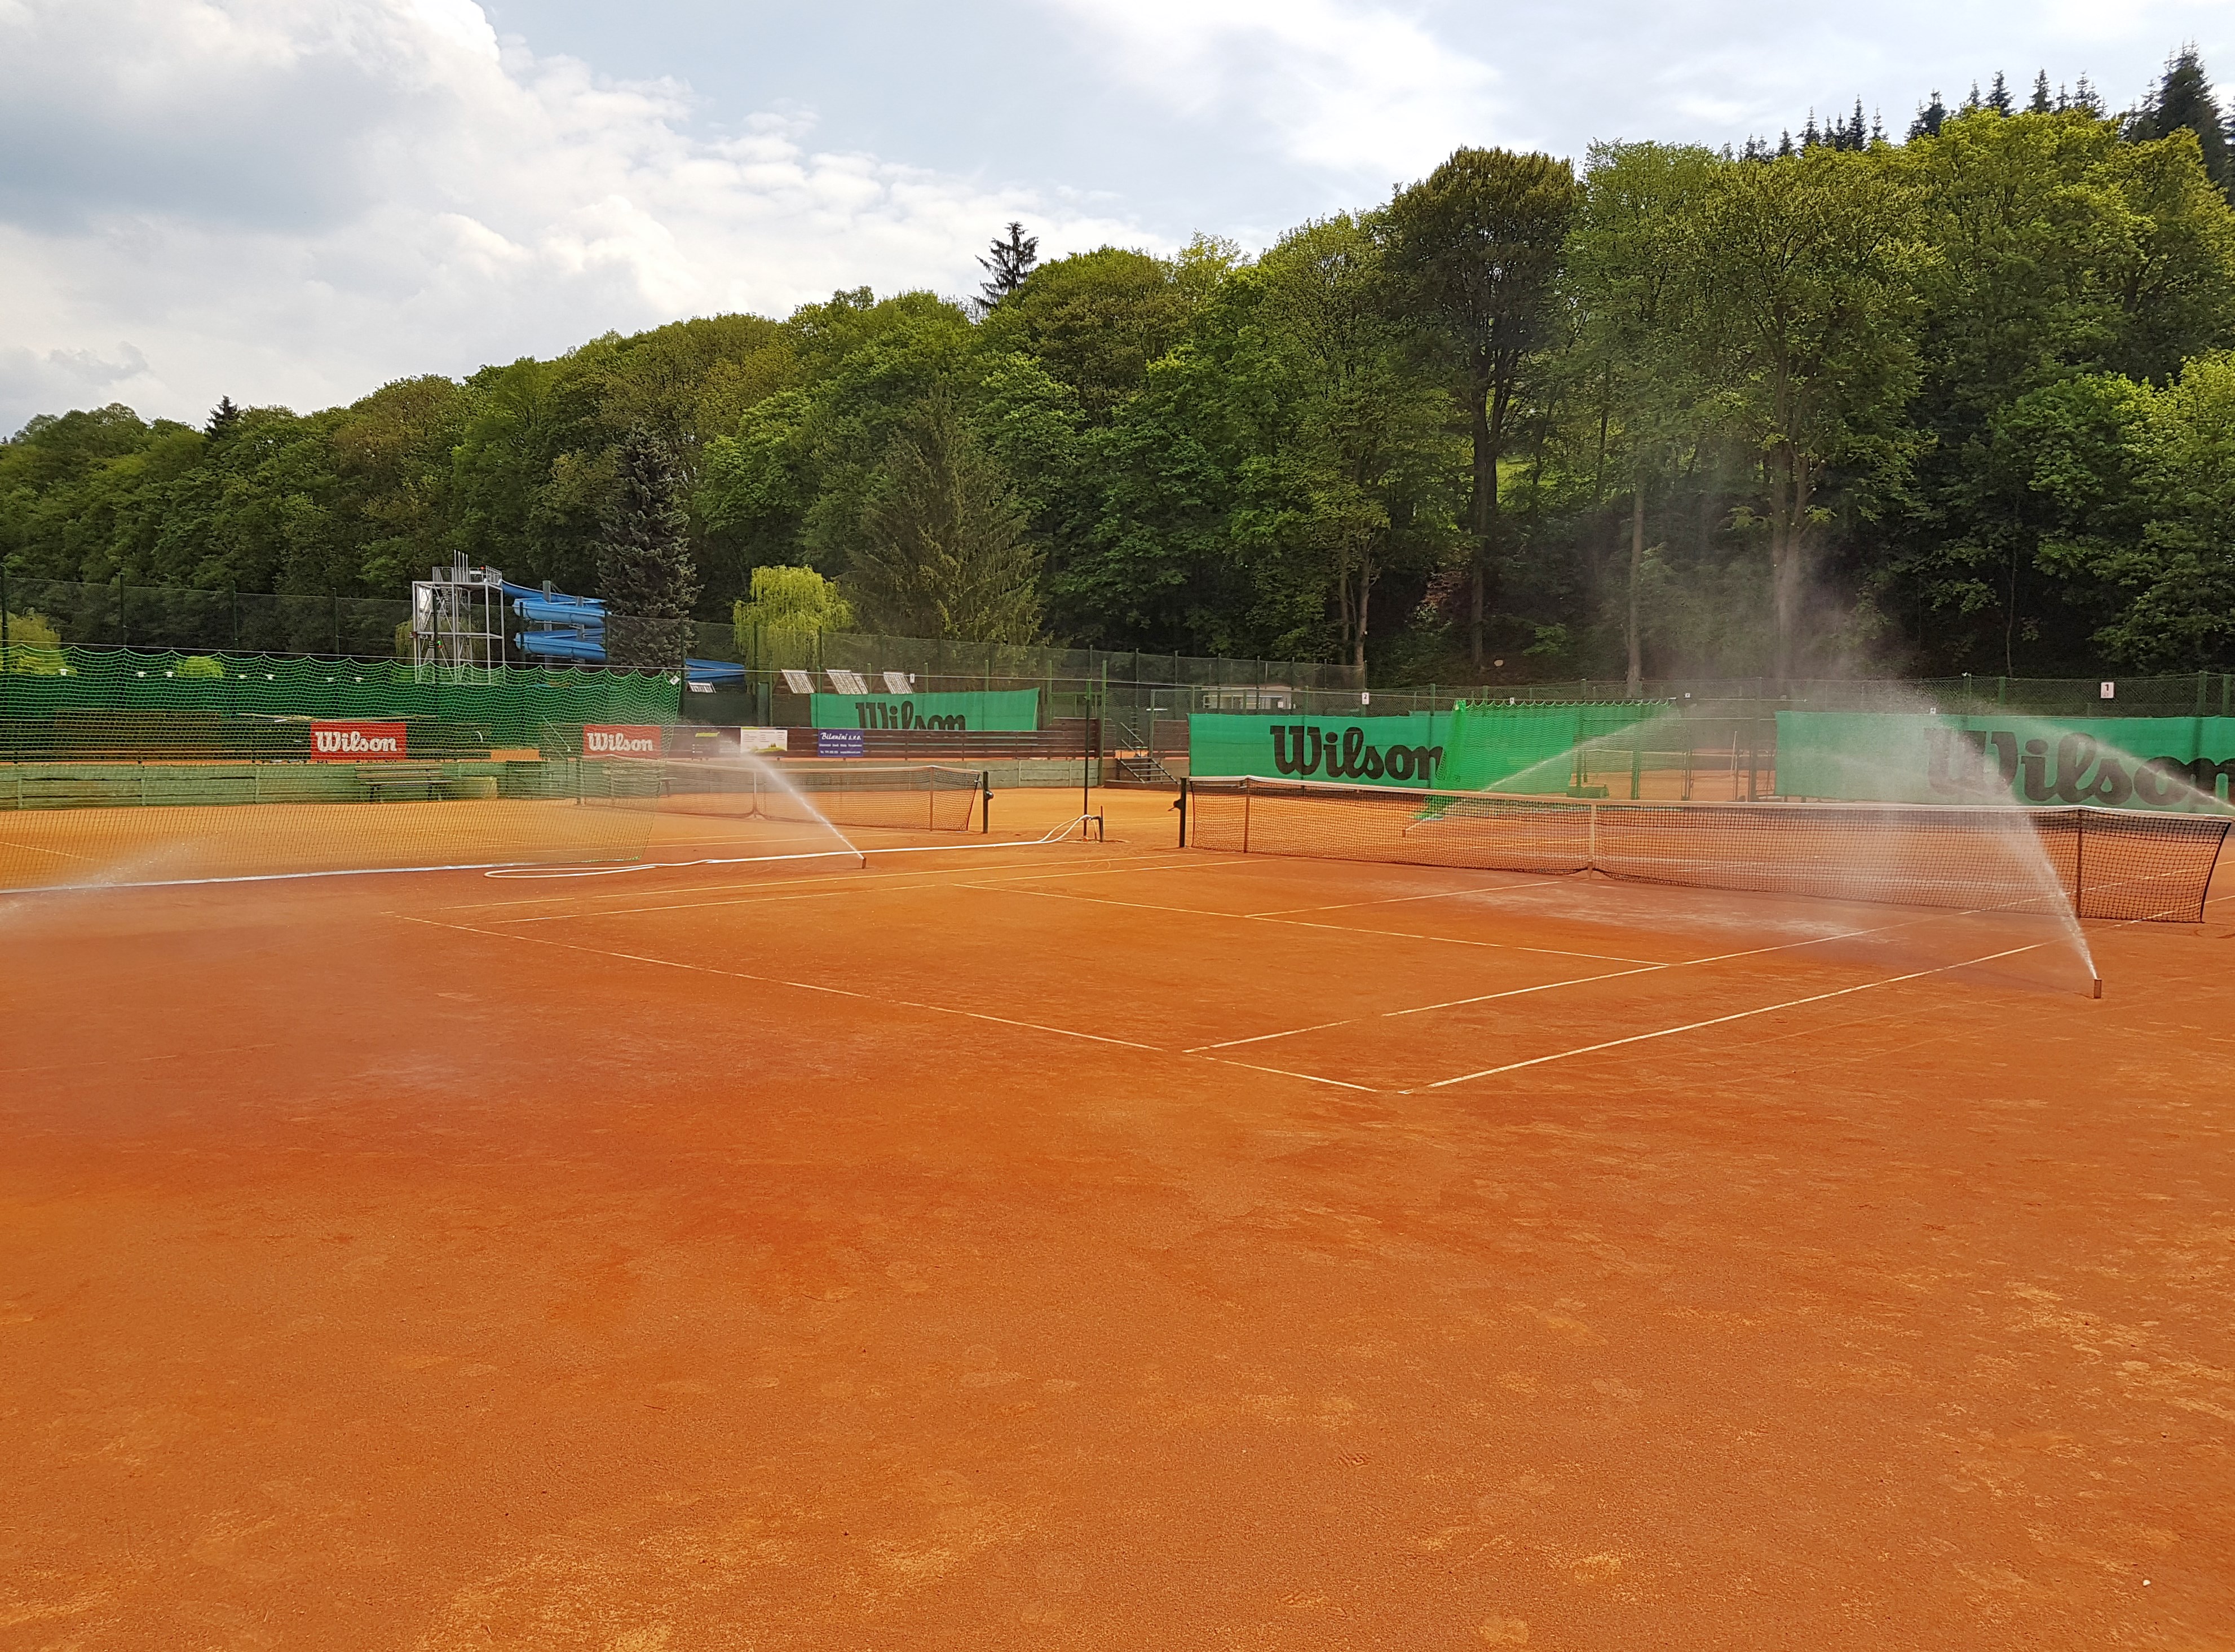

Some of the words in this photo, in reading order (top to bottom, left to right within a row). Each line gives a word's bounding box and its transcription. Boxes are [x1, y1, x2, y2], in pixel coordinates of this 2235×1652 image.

[315, 731, 397, 752] Wilson
[588, 732, 653, 751] Wilson
[1924, 730, 2235, 806] Wilson
